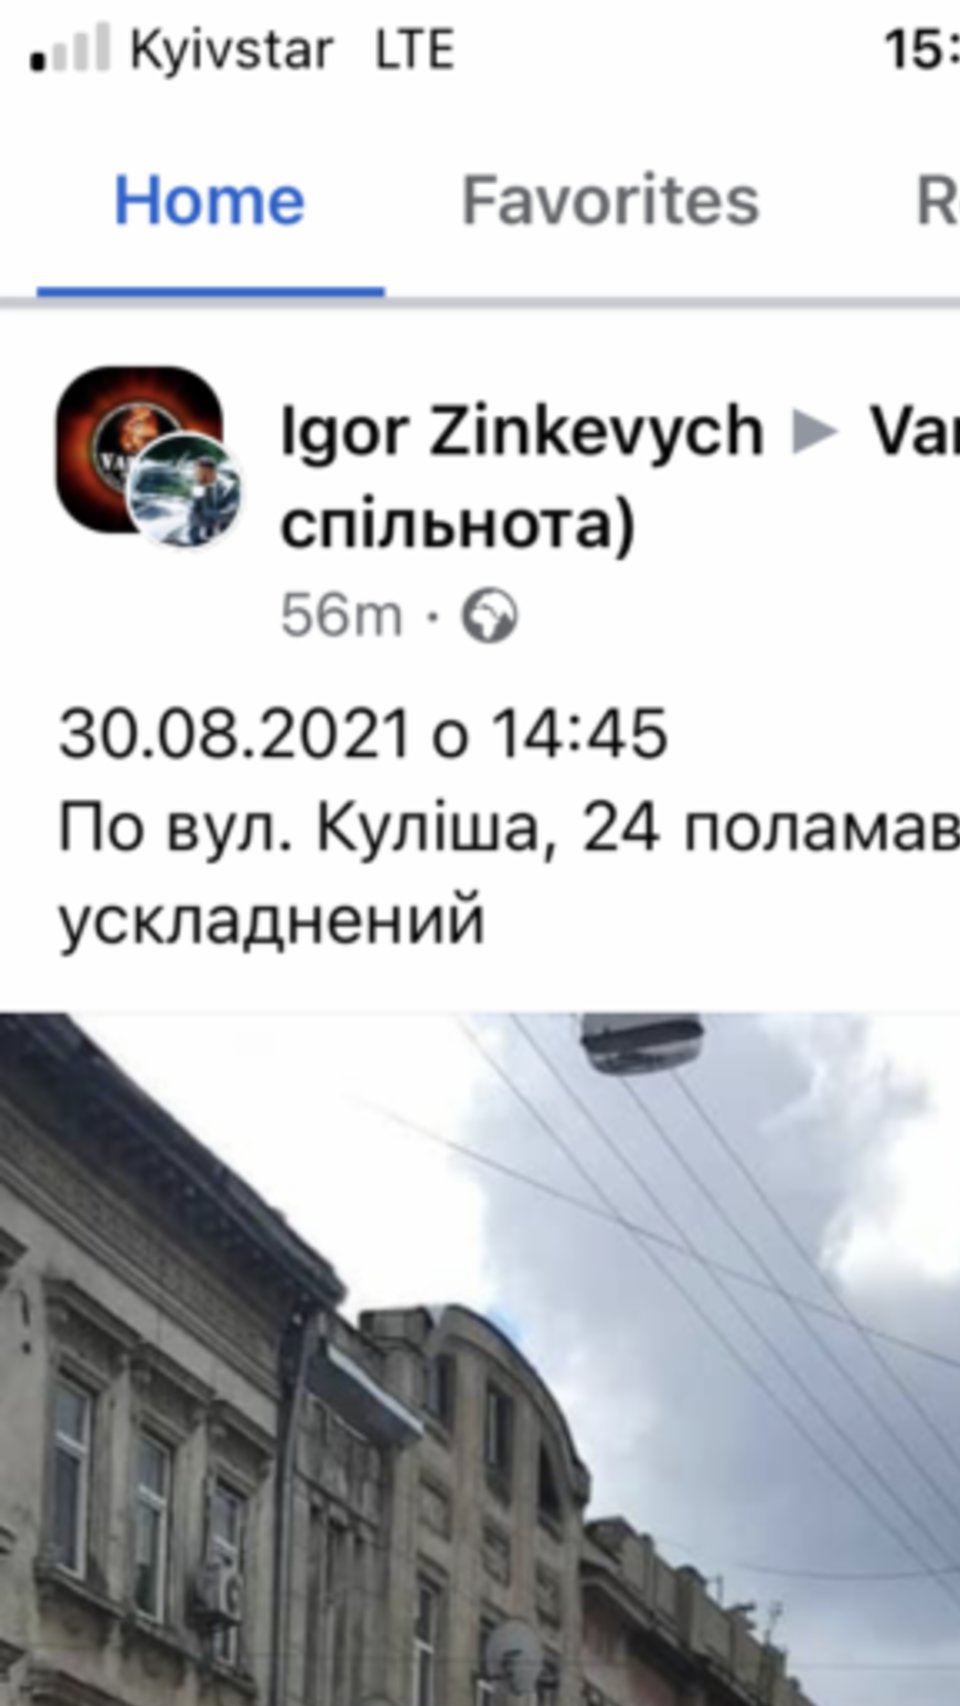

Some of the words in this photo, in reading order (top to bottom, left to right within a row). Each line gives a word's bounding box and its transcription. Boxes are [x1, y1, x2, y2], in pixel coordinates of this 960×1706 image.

[131, 25, 335, 80] Kyivstar
[376, 27, 454, 70] LTE
[115, 173, 306, 226] Home
[464, 171, 760, 225] Favorites
[282, 404, 411, 469] Igor
[429, 400, 763, 469] Zinkevych
[280, 492, 635, 561] спільнота)
[282, 590, 402, 638] 56m
[59, 705, 406, 760] 30.08.2021
[493, 706, 668, 760] 14:45
[60, 799, 145, 852] По
[168, 812, 292, 865] вул.
[319, 797, 557, 865] Куліша,
[584, 798, 661, 852] 24
[58, 889, 483, 958] ускладнений
